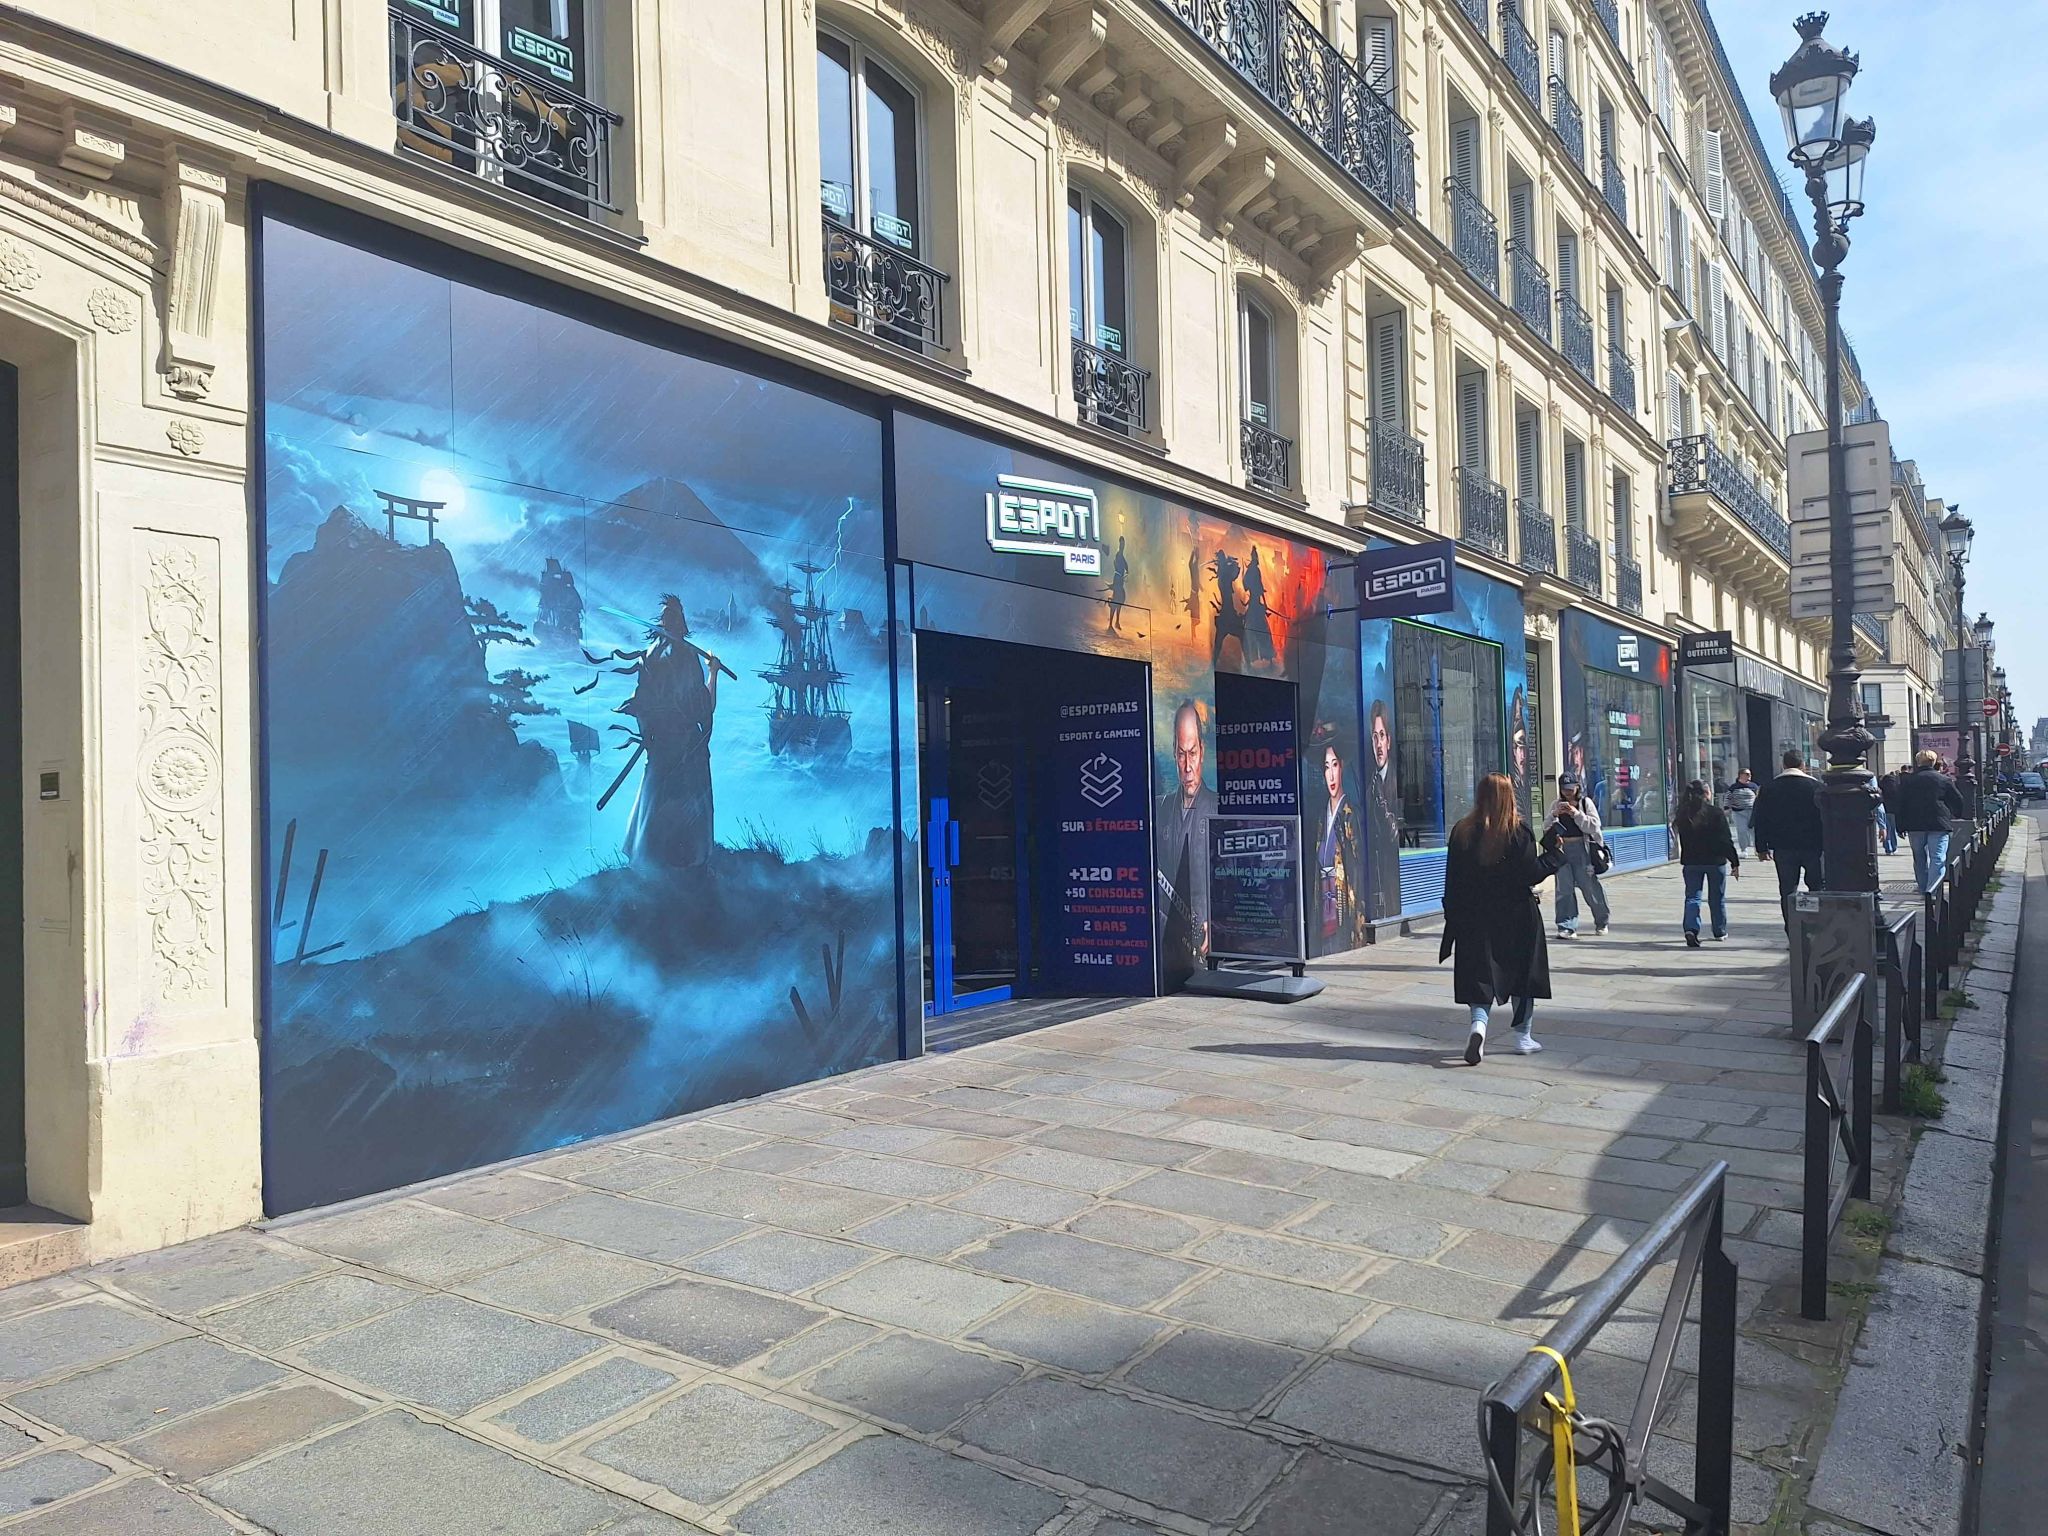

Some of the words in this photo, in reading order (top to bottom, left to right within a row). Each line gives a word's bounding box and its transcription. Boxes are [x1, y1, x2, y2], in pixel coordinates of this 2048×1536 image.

[514, 33, 567, 66] ESPOT
[877, 216, 909, 237] ESPOT
[999, 493, 1090, 540] ESPOT
[1070, 553, 1095, 565] PARIS
[1372, 566, 1437, 592] ESPOT
[1695, 639, 1719, 649] URBAN
[1687, 647, 1728, 658] OUTFITTERS
[1060, 701, 1138, 718] @ESPOTPARIS
[1059, 731, 1093, 741] ESPORT
[1095, 730, 1102, 740] &
[1103, 728, 1141, 739] GAMING
[1225, 779, 1256, 791] POUR
[1258, 778, 1282, 790] VOS
[1062, 821, 1085, 832] SUR
[1086, 821, 1093, 832] 3
[1224, 833, 1280, 851] ESPOT
[1069, 867, 1113, 882] +120
[1116, 867, 1139, 882] PC
[1065, 887, 1086, 898] +50
[1088, 887, 1145, 899] CONSOLES
[1064, 904, 1070, 913] 4
[1071, 904, 1134, 914] SIMULATEURS
[1083, 920, 1091, 931] 2
[1094, 920, 1127, 932] BARS
[1065, 937, 1070, 945] 1
[1074, 953, 1113, 965] SALLE
[1115, 954, 1140, 966] VIP
